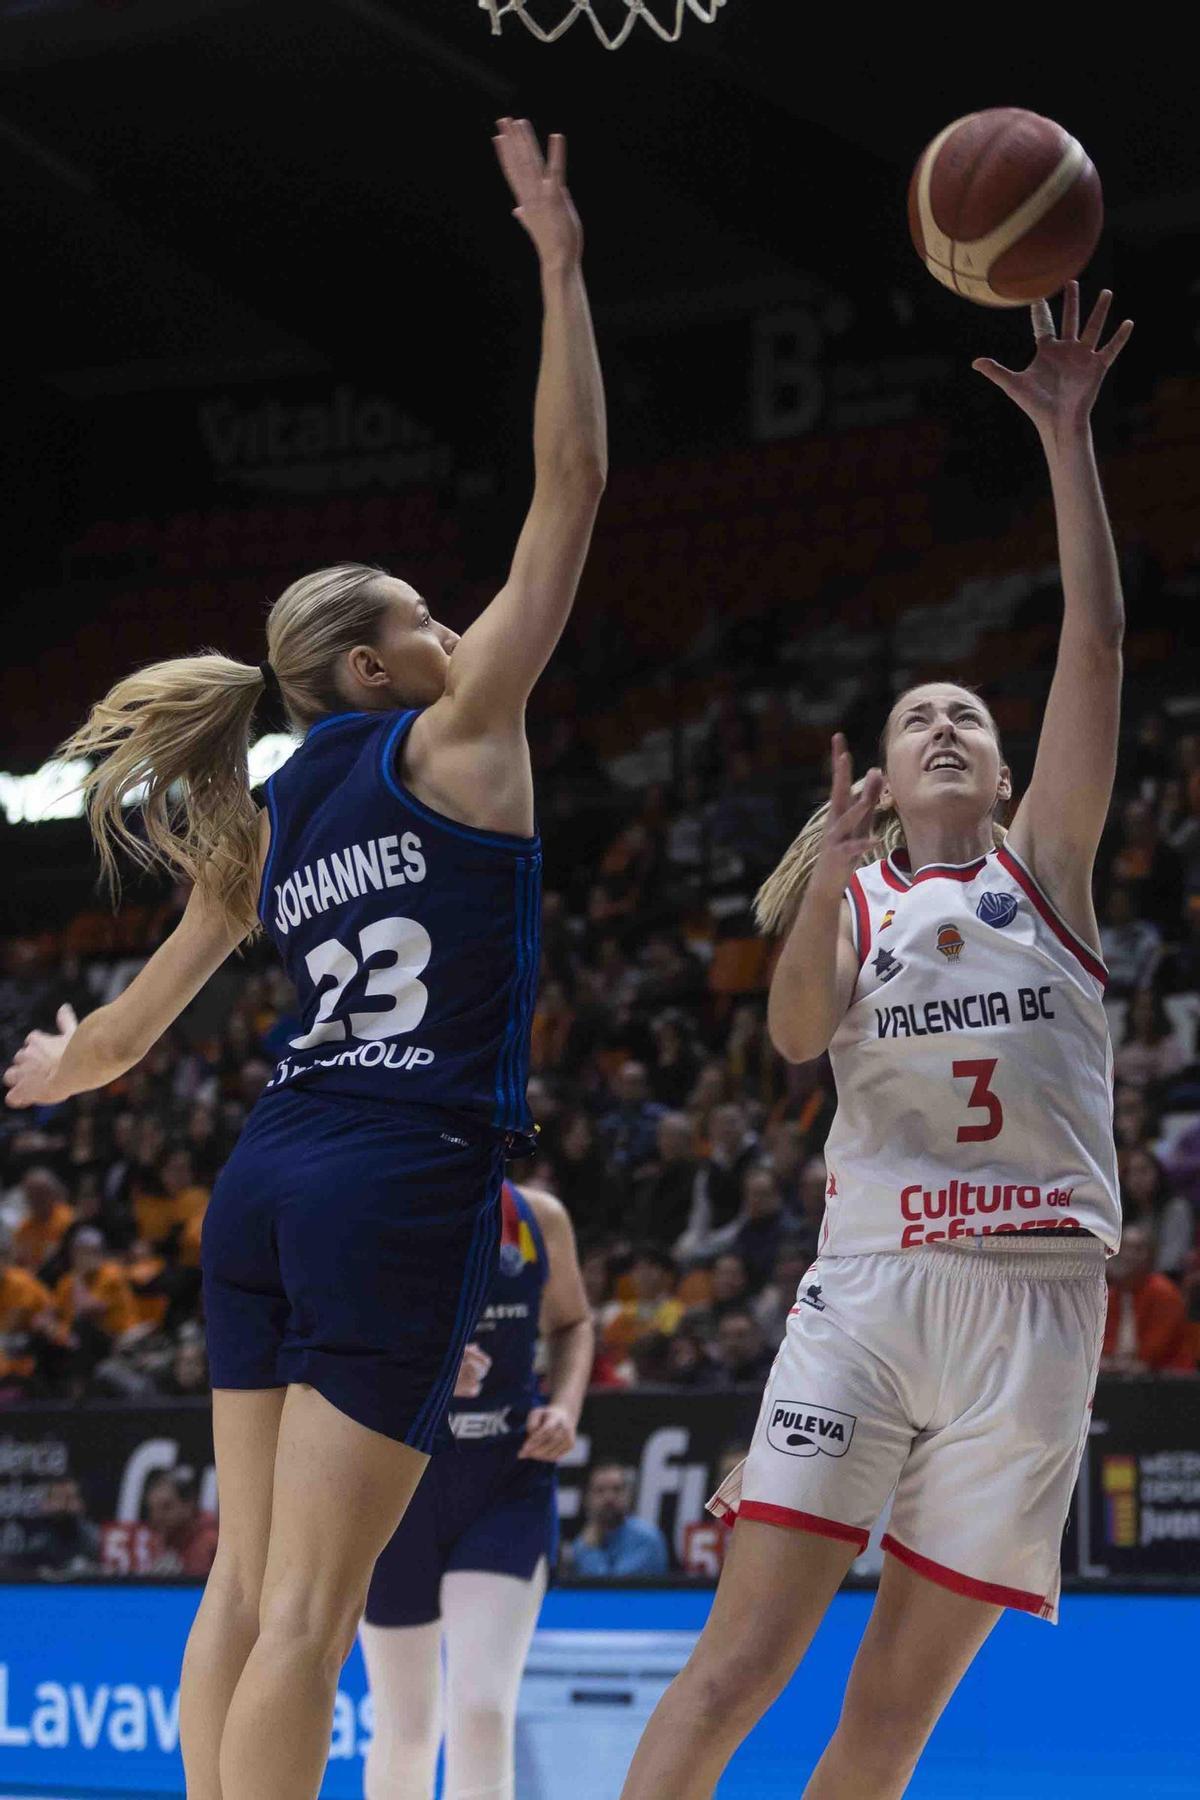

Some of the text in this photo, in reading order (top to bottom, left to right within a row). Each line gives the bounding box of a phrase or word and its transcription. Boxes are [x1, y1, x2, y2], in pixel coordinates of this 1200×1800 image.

[274, 831, 427, 935] JOHANNES
[288, 916, 432, 1050] 23
[875, 986, 1055, 1038] VALENCIA BC
[952, 1058, 1003, 1143] 3
[901, 1180, 1074, 1221] Cultura del
[772, 1408, 844, 1442] PULEVA
[0, 1662, 180, 1752] Lavav
